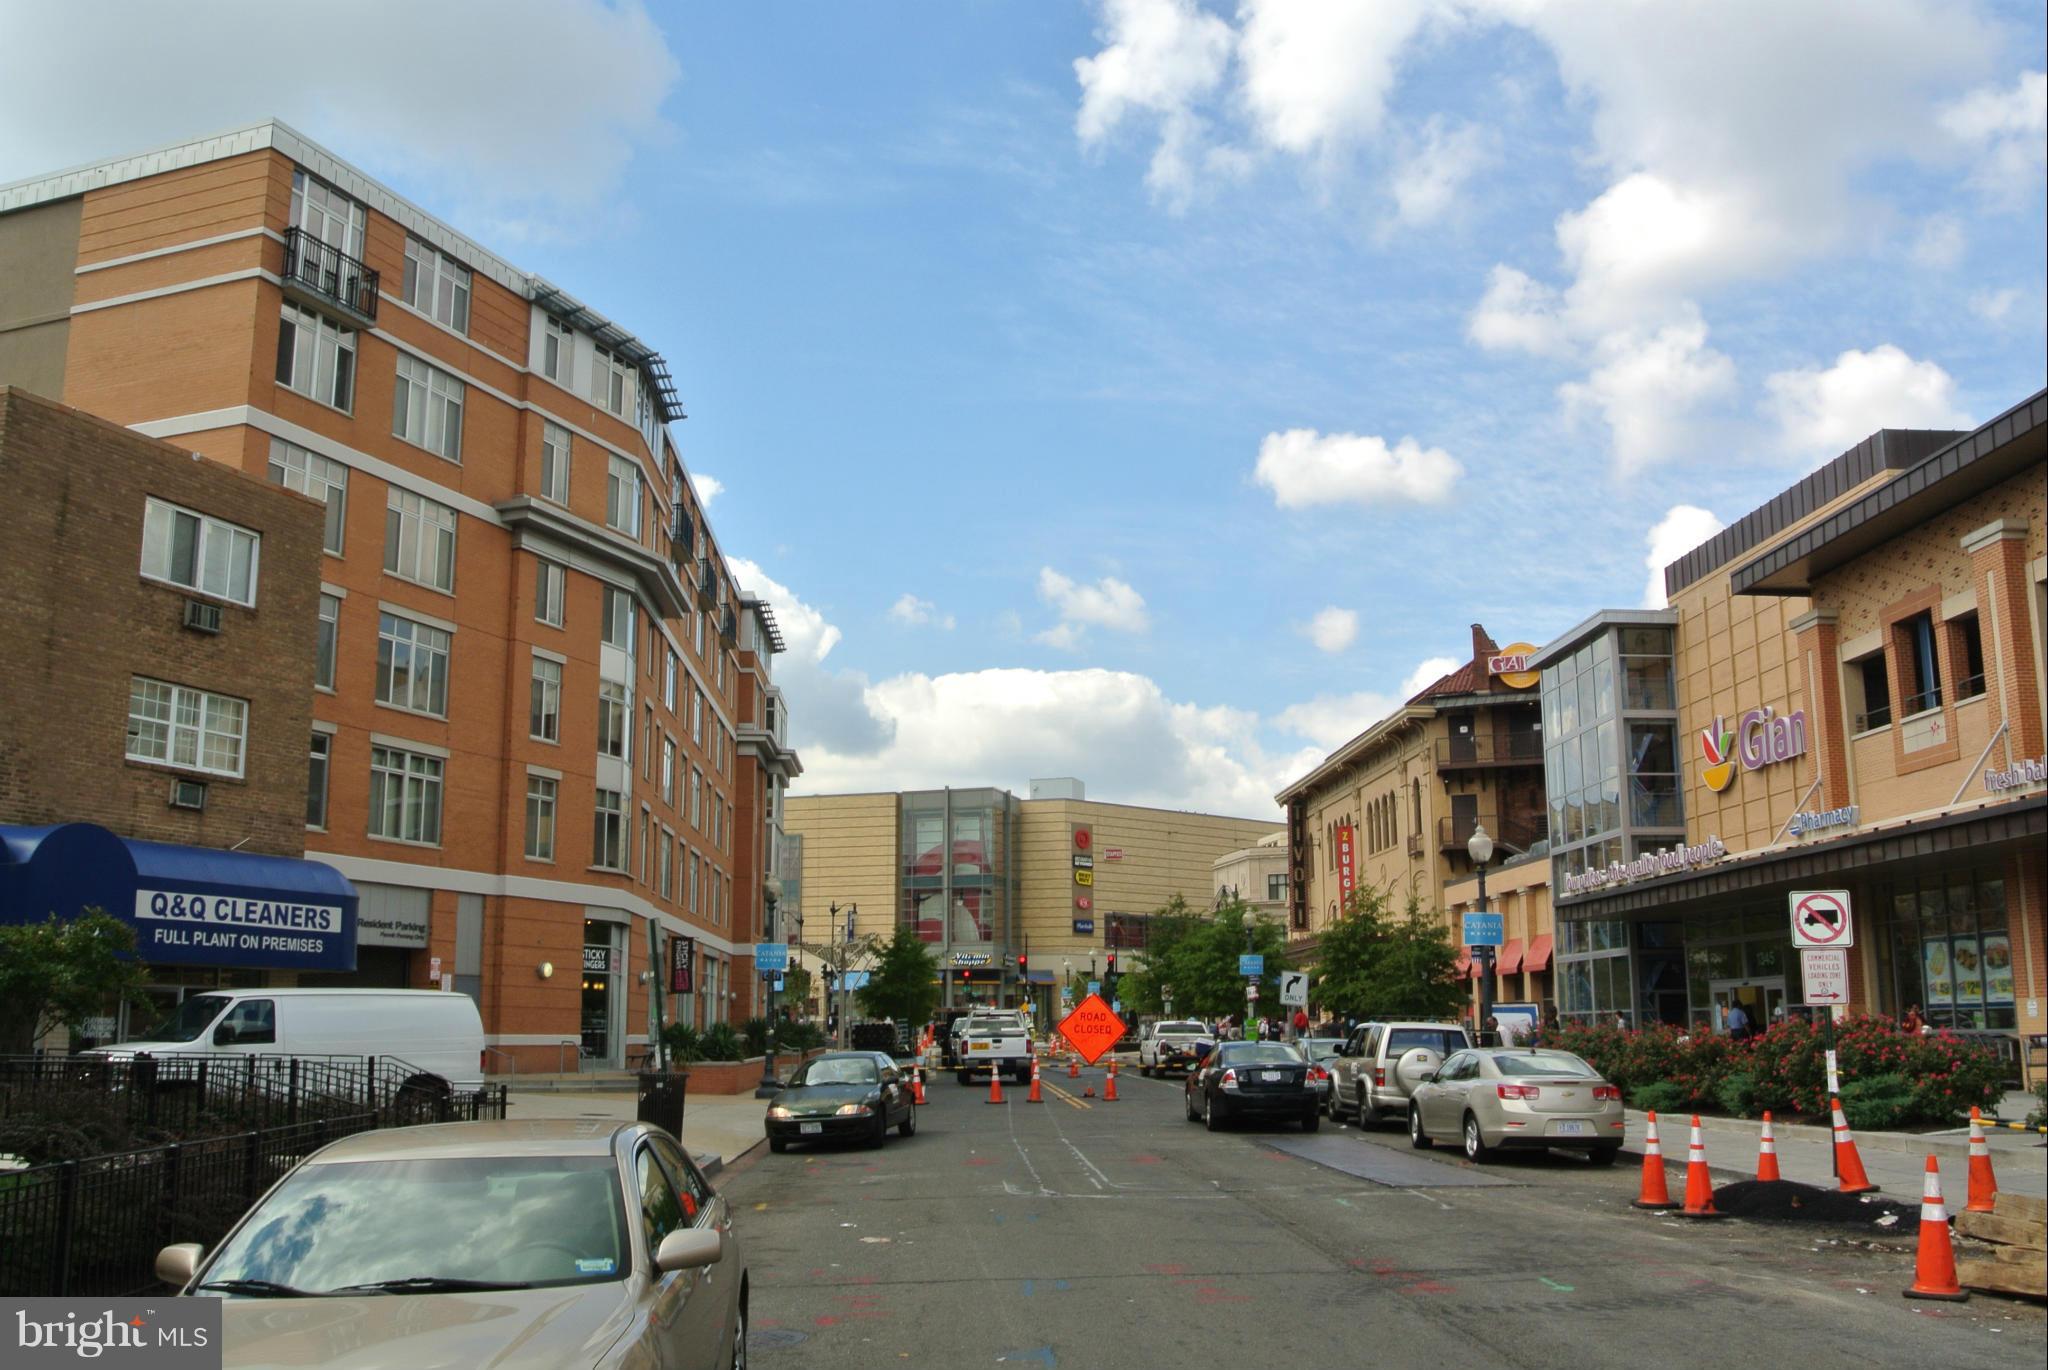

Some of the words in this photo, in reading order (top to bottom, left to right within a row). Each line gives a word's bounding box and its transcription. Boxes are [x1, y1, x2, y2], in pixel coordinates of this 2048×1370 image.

[1739, 705, 1808, 770] Gian
[1984, 763, 2020, 792] fresh
[1800, 806, 1855, 829] Pharmacy
[1657, 843, 1684, 868] food
[151, 893, 206, 921] Q&Q
[214, 898, 331, 930] CLEANERS
[357, 918, 393, 930] Resident
[395, 921, 426, 933] Parking
[1464, 921, 1503, 929] CATANIA
[154, 928, 190, 945] FULL
[193, 931, 238, 948] PLANT
[240, 934, 258, 949] ON
[262, 936, 324, 953] PREMISES
[583, 960, 606, 969] INGERS
[1284, 993, 1303, 1001] ONLY
[1080, 1012, 1107, 1021] ROAD
[1074, 1025, 1112, 1034] CLOSED
